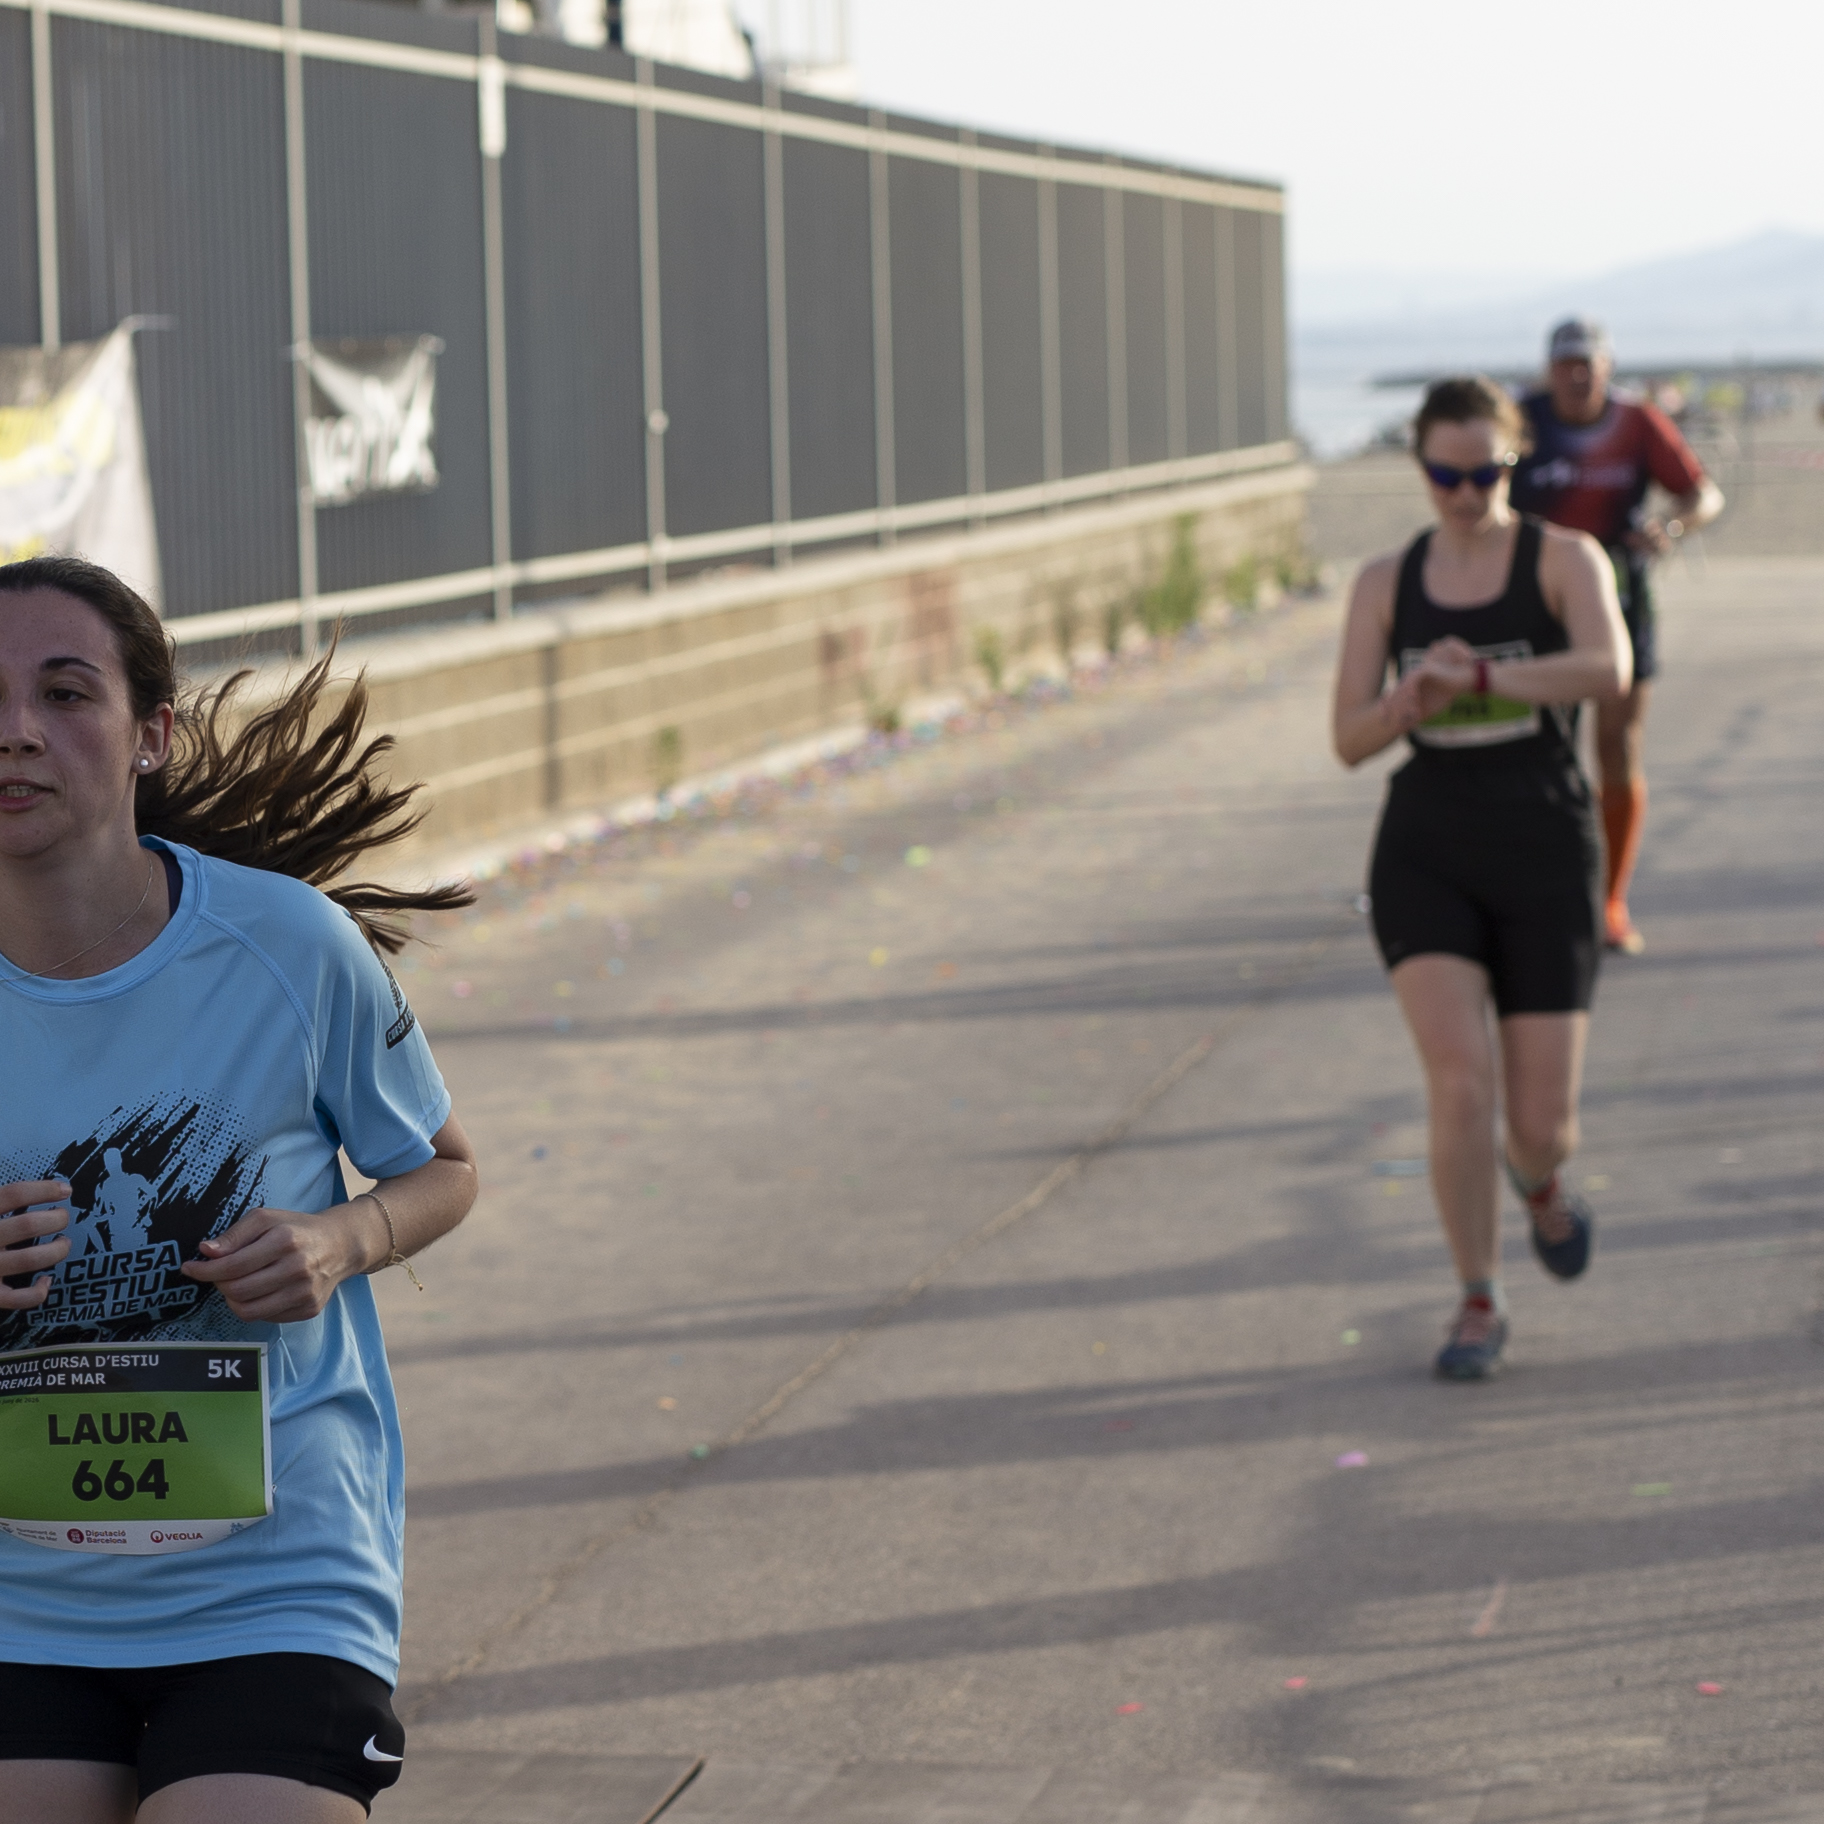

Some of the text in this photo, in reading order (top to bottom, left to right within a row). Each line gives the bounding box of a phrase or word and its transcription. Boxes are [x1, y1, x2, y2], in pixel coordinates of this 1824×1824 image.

[64, 1244, 177, 1284] CURSA
[42, 1272, 162, 1310] D'ESTIU
[110, 1299, 141, 1316] DE
[144, 1288, 195, 1309] MAR
[42, 1355, 90, 1370] CURSA
[208, 1359, 242, 1379] 5K
[46, 1373, 66, 1386] DE
[71, 1372, 106, 1385] MAR
[48, 1411, 189, 1446] LAURA
[72, 1458, 170, 1502] 664
[85, 1529, 126, 1538] Diputació
[86, 1537, 127, 1545] Barcelona
[165, 1532, 203, 1541] VEOLIA
